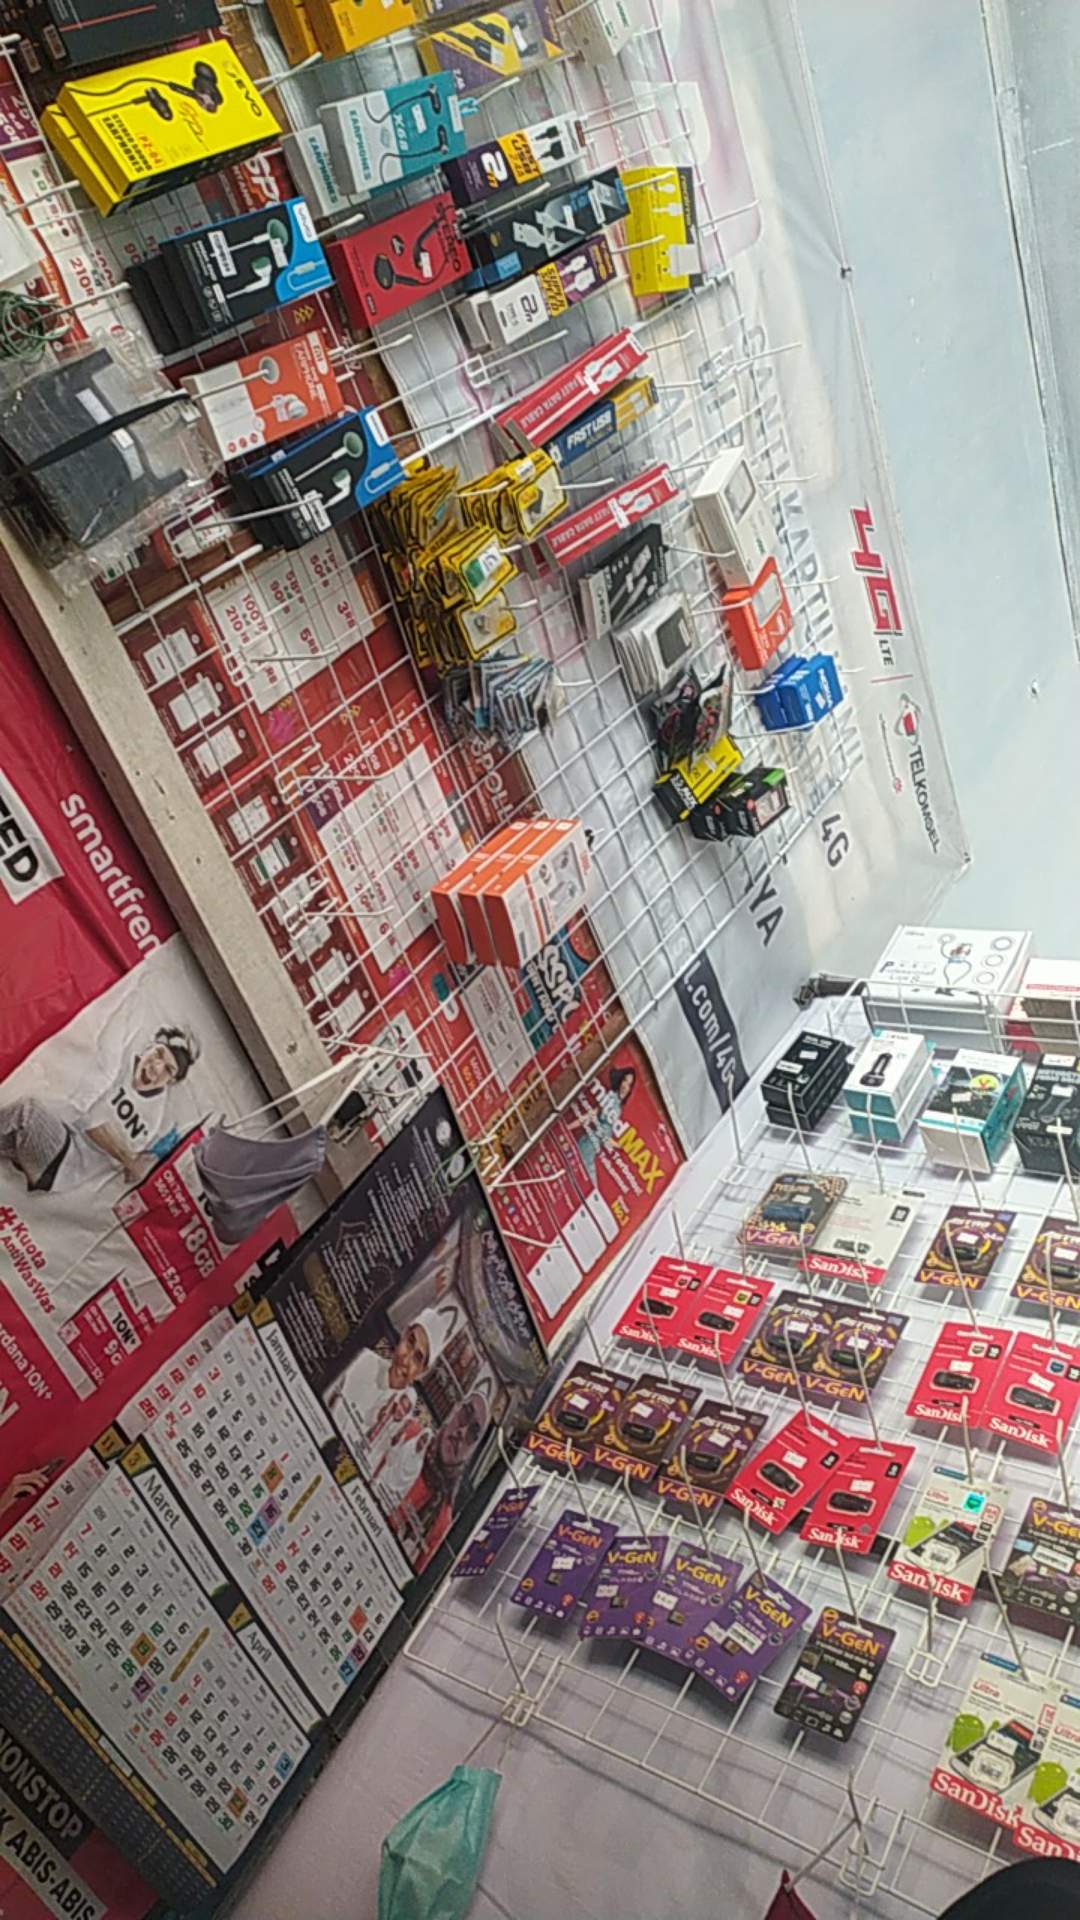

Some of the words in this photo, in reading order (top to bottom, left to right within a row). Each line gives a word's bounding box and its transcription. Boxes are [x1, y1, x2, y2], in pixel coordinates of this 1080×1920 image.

[235, 79, 262, 117] EVO
[102, 116, 143, 174] EARPHONES
[348, 108, 374, 181] EARPHONES
[509, 135, 533, 175] USB
[515, 131, 542, 177] FAST
[307, 135, 339, 203] EARPHONES
[539, 268, 561, 313] SPEED
[545, 265, 567, 308] SUPER
[519, 406, 544, 427] CABLE
[542, 392, 562, 409] DATA
[550, 527, 575, 547] CABLE
[574, 516, 594, 532] DATA
[848, 500, 905, 634] 4G
[877, 637, 894, 668] LTE
[909, 745, 940, 852] TELKOMSEL
[813, 814, 857, 866] 4G
[11, 1222, 48, 1269] Kuota
[175, 1215, 224, 1276] 18GB
[0, 1233, 56, 1314] AntiWasWas
[809, 1255, 871, 1281] SanDisk
[265, 1330, 299, 1383] Januari
[804, 1376, 864, 1401] V-GeN
[988, 1416, 1050, 1447] SanDisk
[143, 1476, 181, 1528] Maret
[349, 1486, 383, 1537] Februari
[557, 1524, 602, 1548] V-GeN
[607, 1549, 657, 1564] V-GeN
[673, 1558, 726, 1588] V-GeN
[744, 1586, 793, 1628] V-GeN
[244, 1629, 274, 1663] April
[820, 1623, 880, 1654] V-GeN
[972, 1680, 1000, 1698] Ultra
[932, 1771, 1023, 1830] SanDisk
